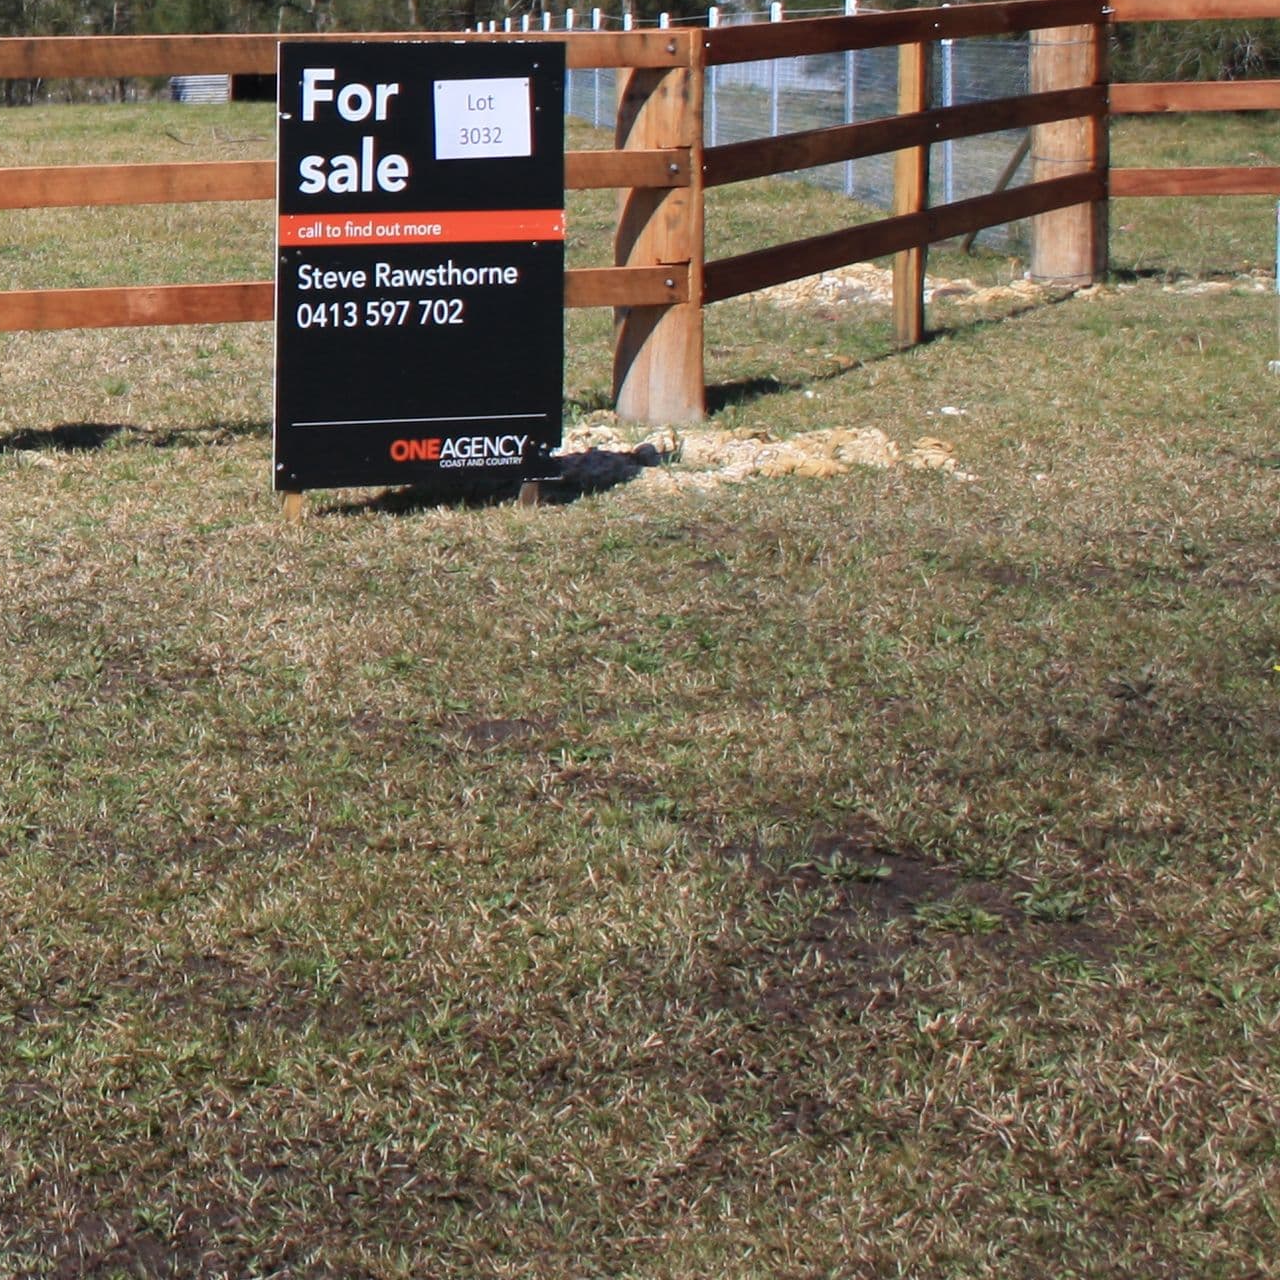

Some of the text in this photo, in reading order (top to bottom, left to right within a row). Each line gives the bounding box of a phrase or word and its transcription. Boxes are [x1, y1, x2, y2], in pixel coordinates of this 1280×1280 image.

[302, 68, 400, 121] For
[467, 94, 495, 111] Lot
[459, 126, 503, 145] 3032
[298, 136, 410, 194] sale
[297, 221, 442, 238] call to find out more
[297, 259, 519, 290] Steve Rawsthorne
[296, 298, 464, 328] 0413 597 702
[439, 456, 523, 468] COAST AND COUNTRY
